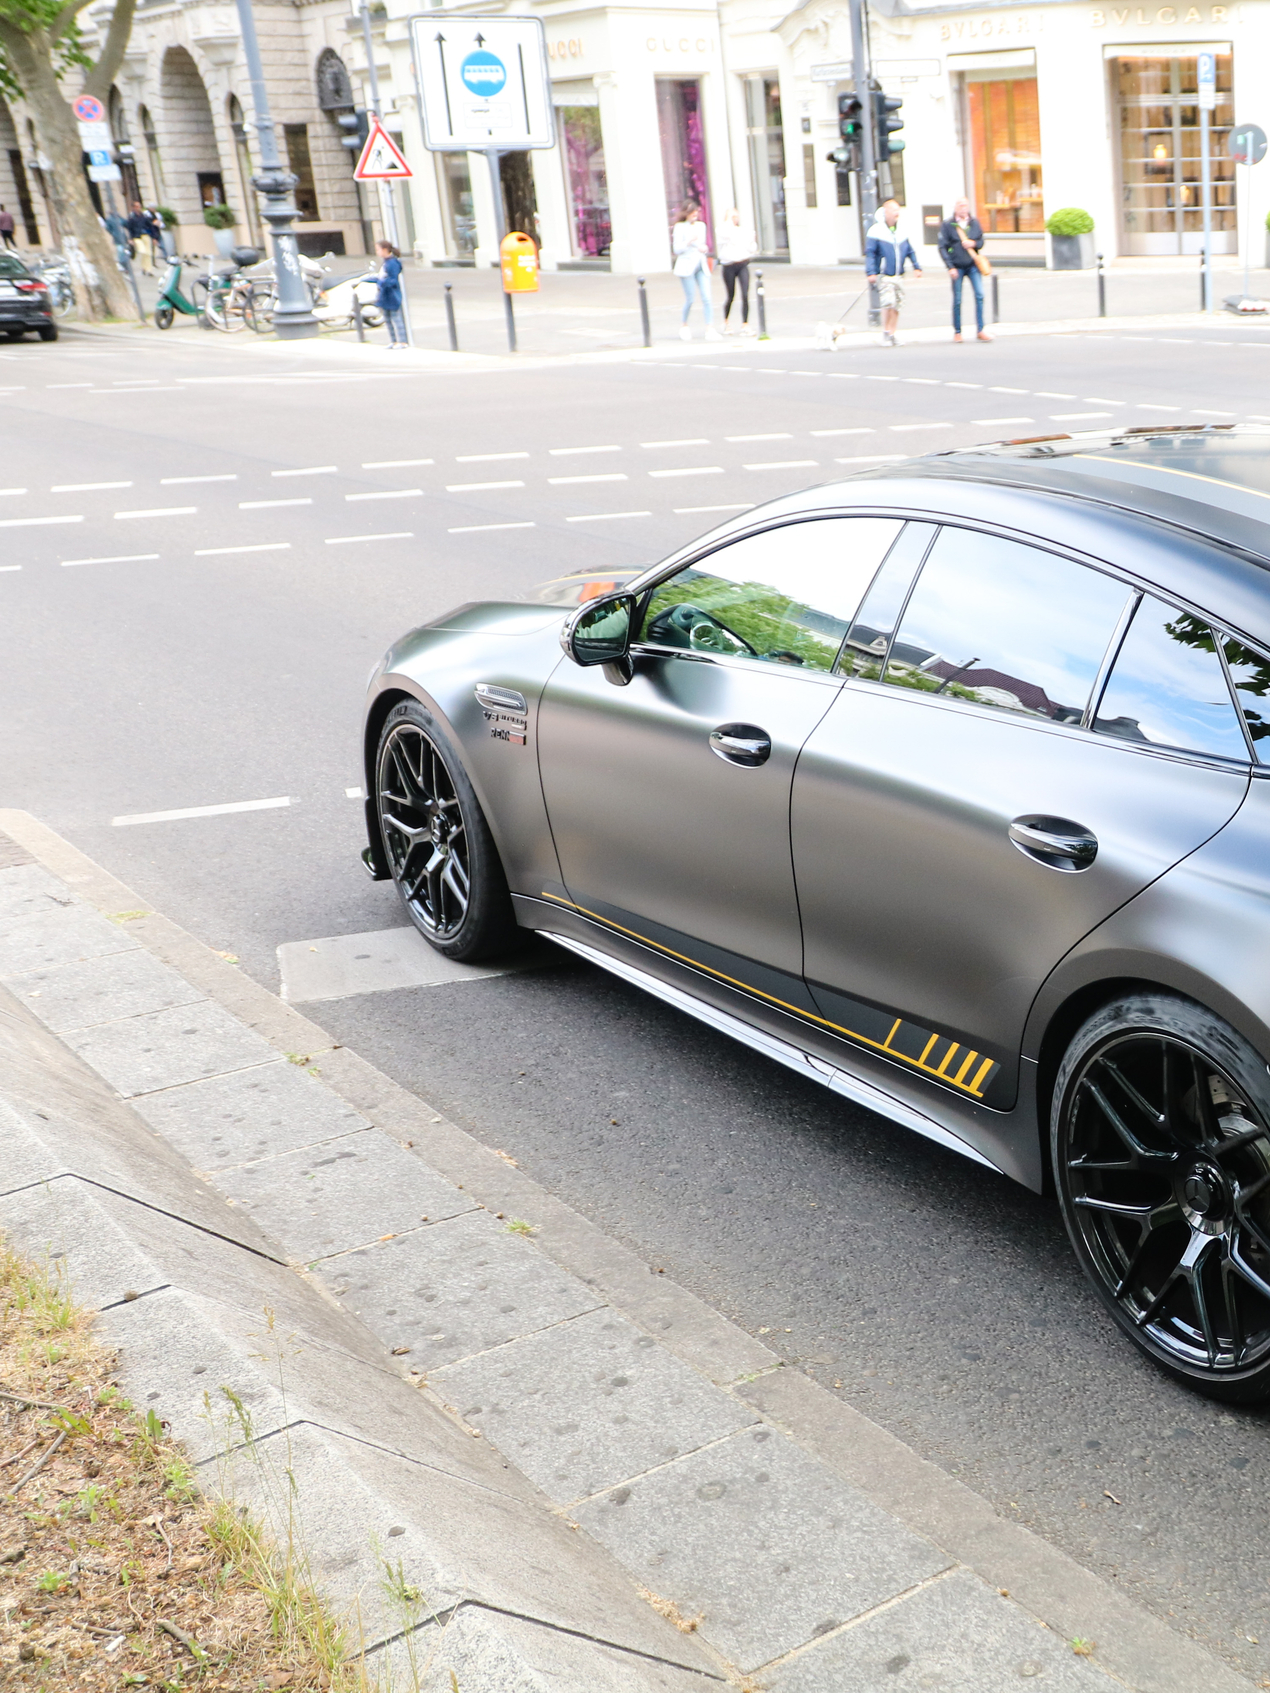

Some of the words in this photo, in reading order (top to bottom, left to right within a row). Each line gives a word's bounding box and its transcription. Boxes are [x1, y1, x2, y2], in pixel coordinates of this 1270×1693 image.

[940, 15, 1043, 41] BVLGARI
[1090, 6, 1244, 28] BVLGARI
[646, 37, 714, 53] GUCCI
